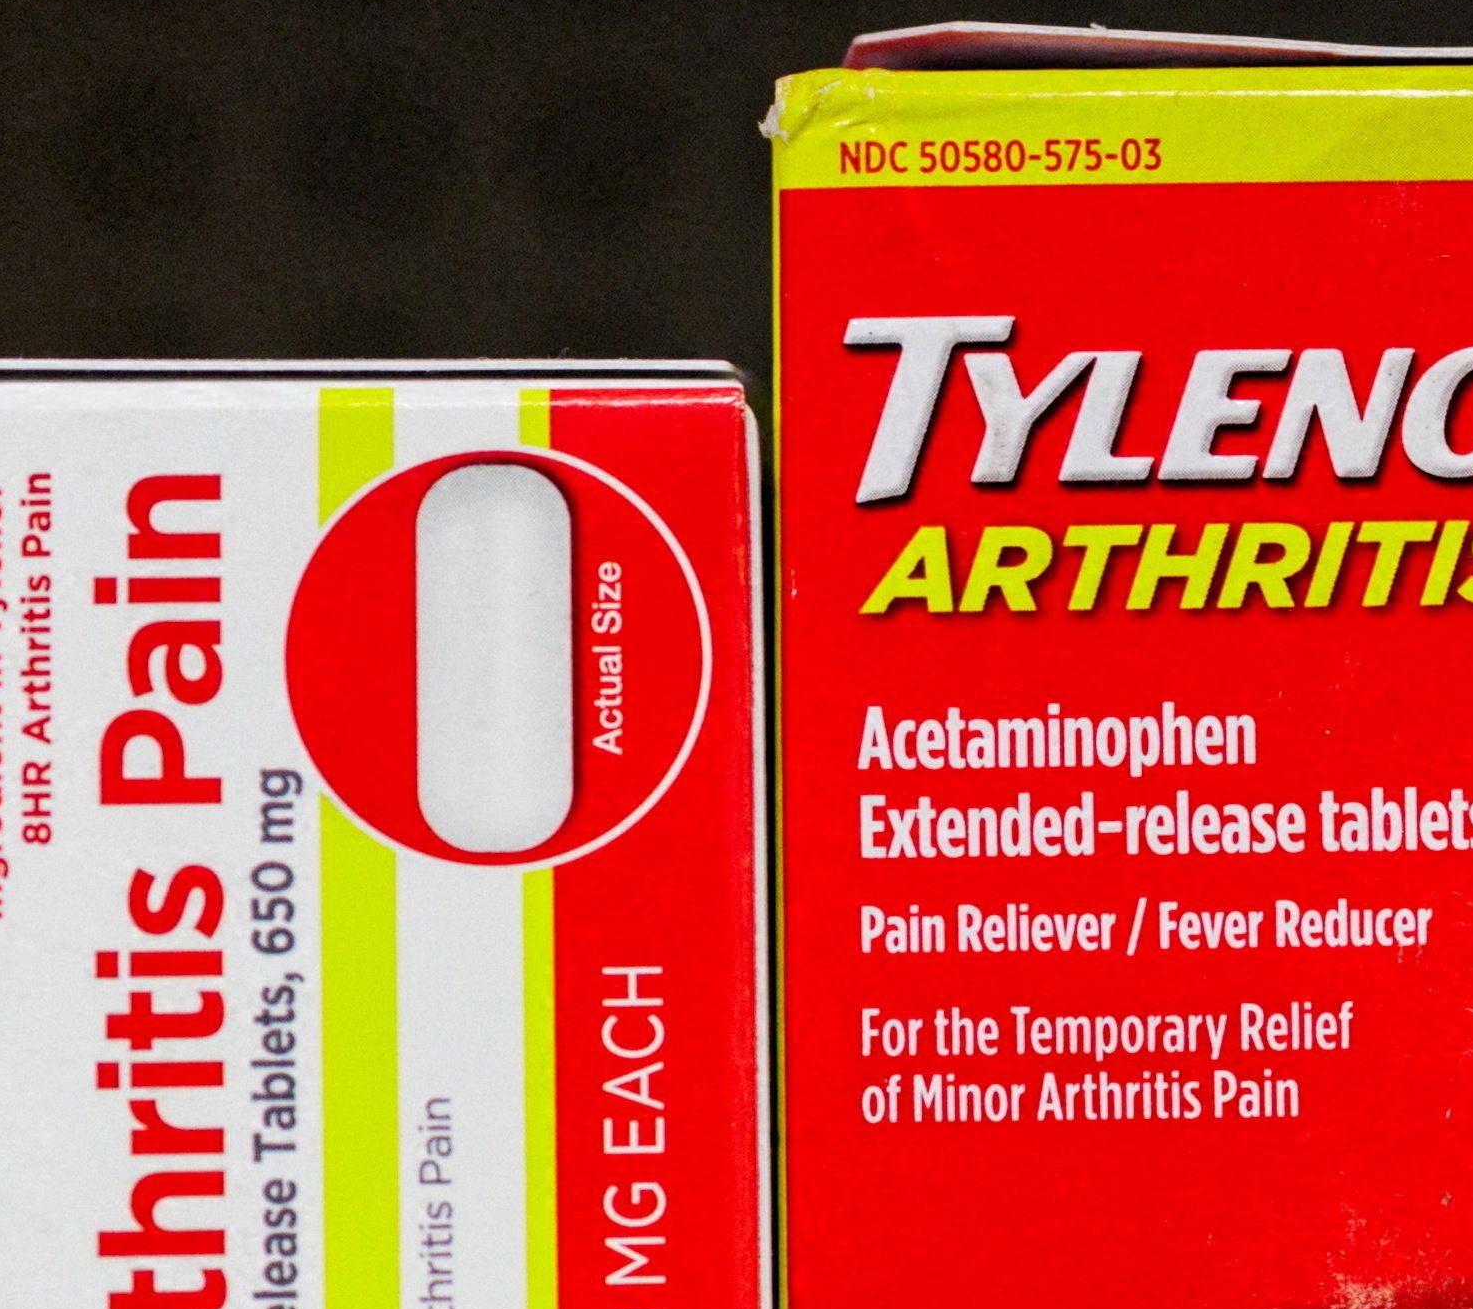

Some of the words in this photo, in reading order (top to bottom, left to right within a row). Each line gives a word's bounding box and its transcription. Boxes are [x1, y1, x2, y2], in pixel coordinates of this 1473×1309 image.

[840, 141, 908, 174] NDC
[920, 138, 1161, 173] 50580-575-03
[20, 473, 51, 557] Pain
[94, 474, 223, 805] Pain
[591, 562, 622, 634] Size
[20, 575, 51, 744] Arthritis
[592, 646, 623, 755] Actual
[858, 701, 1256, 777] Acetaminophen
[22, 762, 52, 844] 8HR
[260, 766, 302, 843] mg
[860, 790, 1306, 858] Extended-release
[250, 861, 295, 955] 650
[861, 905, 945, 953] Pain
[958, 904, 1116, 952] Reliever
[1159, 902, 1263, 949] Fever
[1276, 899, 1432, 947] Reducer
[250, 973, 304, 1163] Tablets,
[602, 966, 665, 1154] EACH
[862, 1008, 923, 1056] For
[934, 1007, 999, 1056] the
[1011, 1006, 1227, 1062] Temporary
[1241, 1001, 1353, 1051] Relief
[862, 1074, 901, 1123] of
[913, 1074, 1025, 1122] Minor
[1037, 1070, 1201, 1120] Arthritis
[1214, 1069, 1299, 1118] Pain
[417, 1097, 453, 1185] Pain
[603, 1182, 666, 1285] MG
